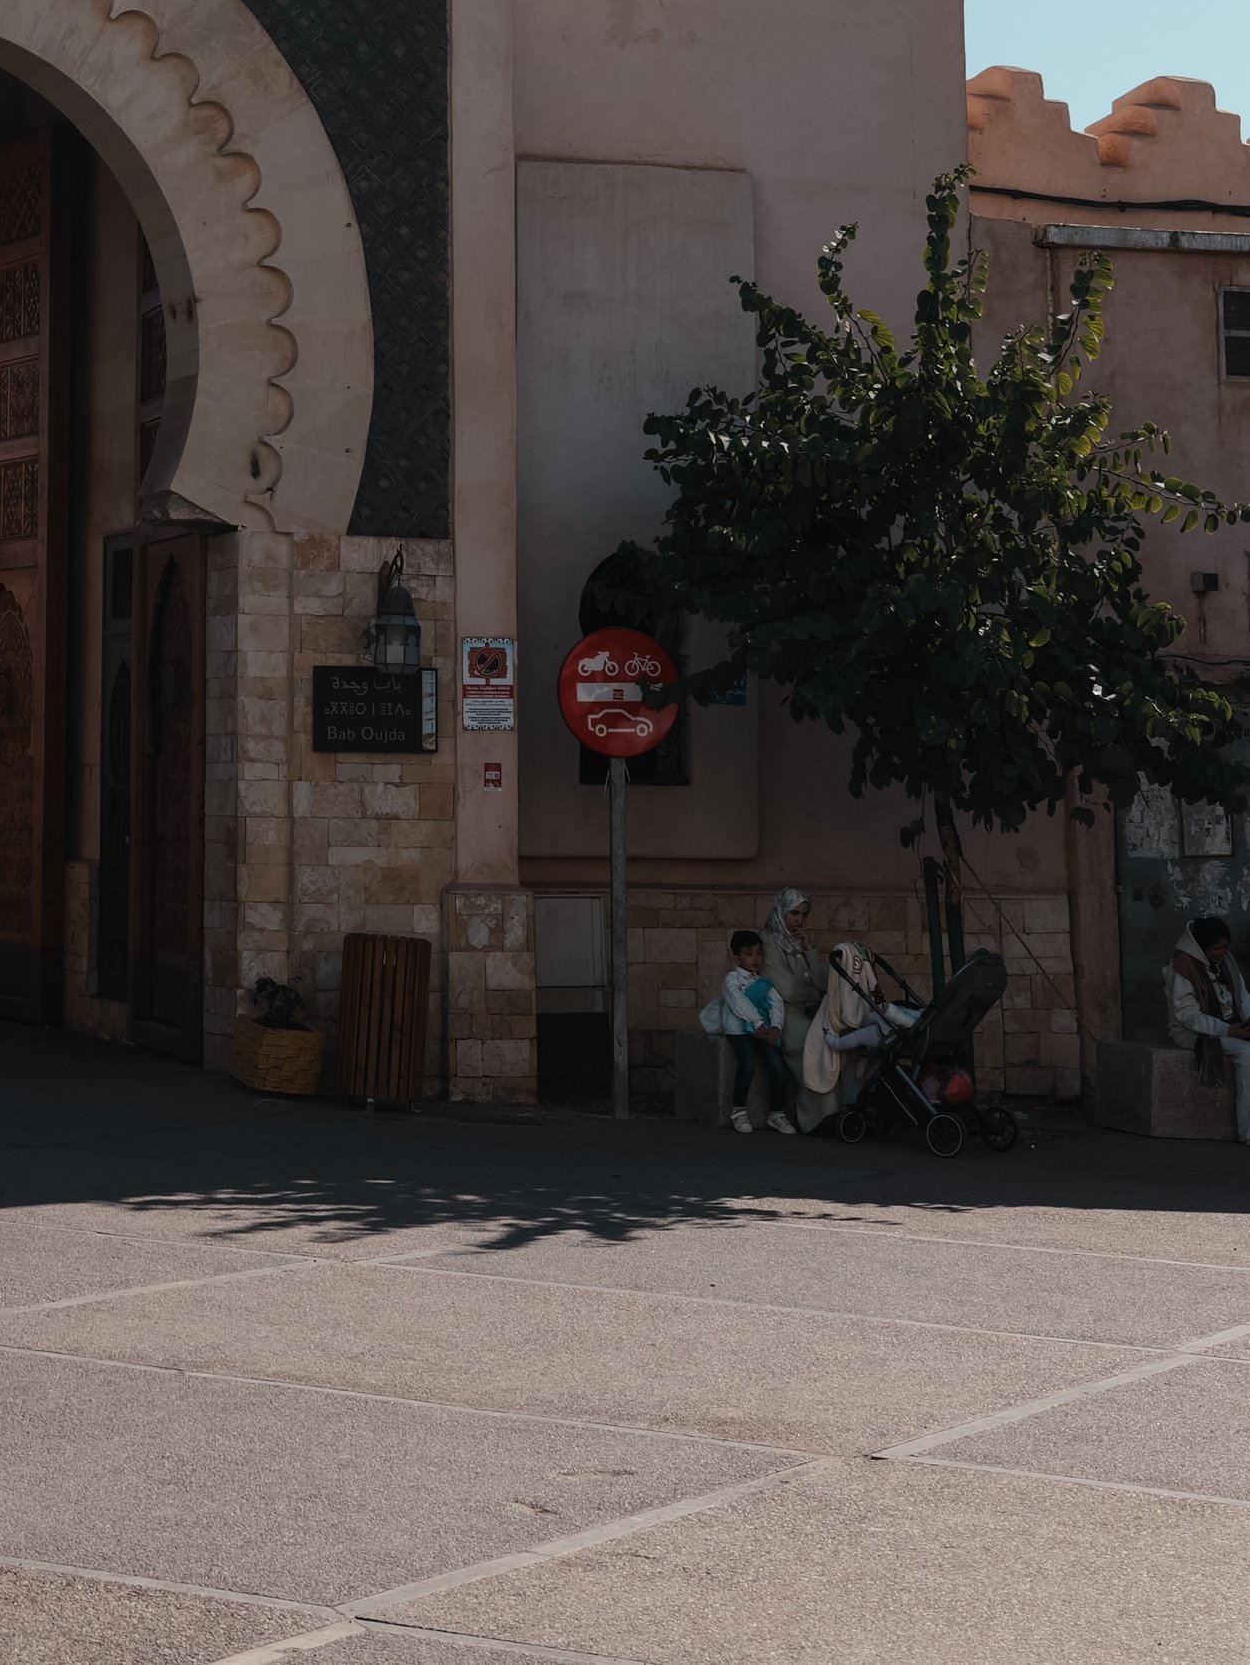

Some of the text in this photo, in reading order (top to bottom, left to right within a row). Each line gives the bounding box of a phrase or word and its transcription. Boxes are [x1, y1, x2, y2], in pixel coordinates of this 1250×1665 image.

[330, 675, 402, 696] باب وجدة
[327, 725, 405, 744] Bab Oujda
